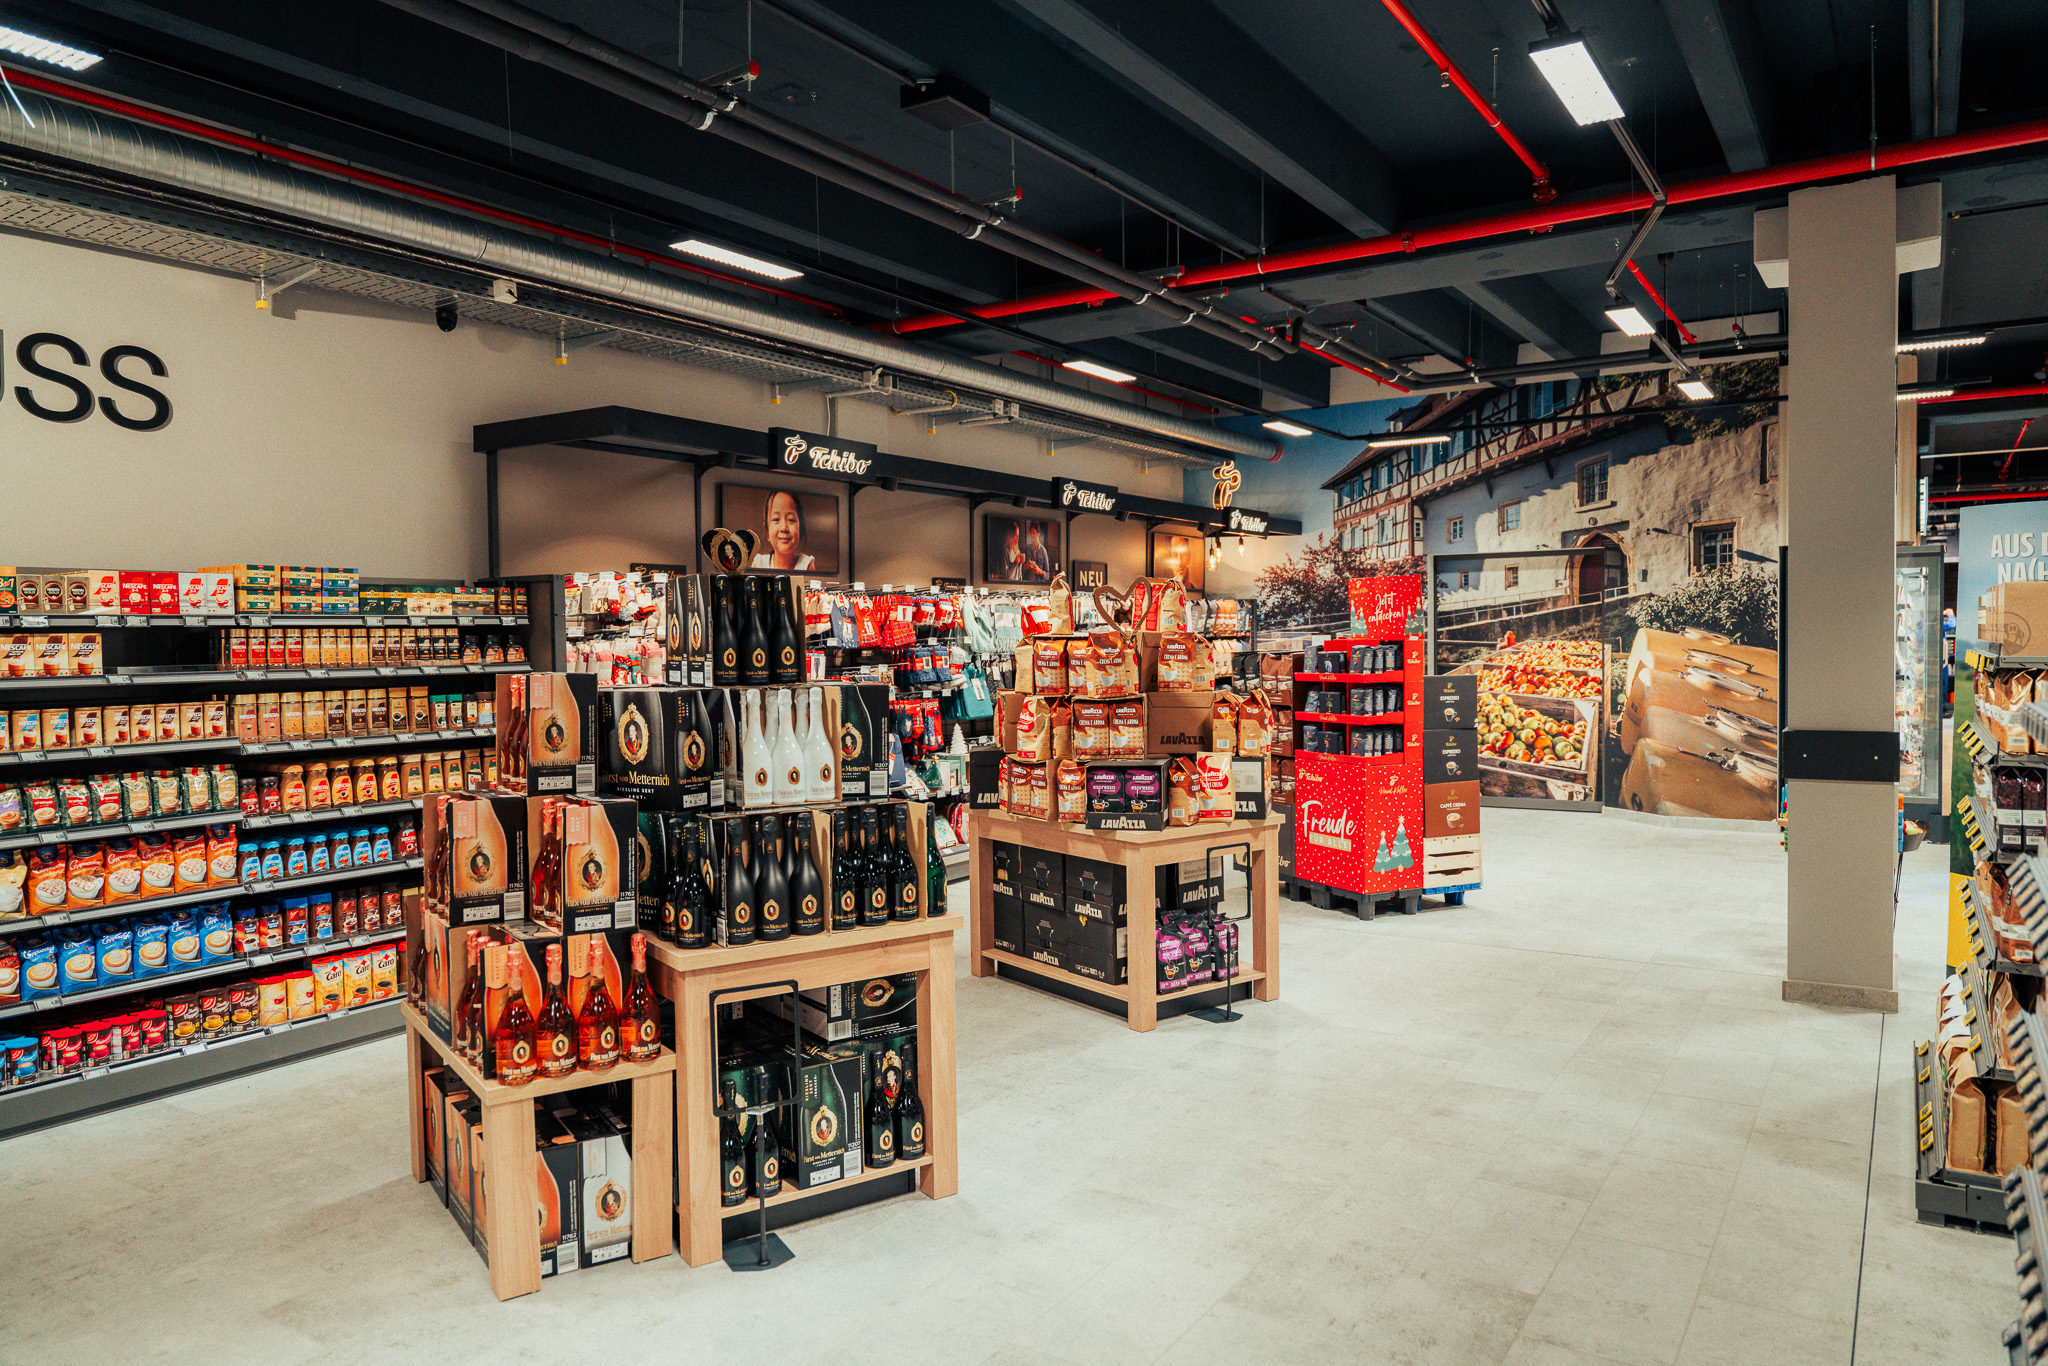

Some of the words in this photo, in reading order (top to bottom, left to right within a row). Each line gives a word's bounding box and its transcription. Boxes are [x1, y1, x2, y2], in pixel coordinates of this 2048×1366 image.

[809, 446, 871, 474] Tchibo
[1078, 490, 1115, 510] Tchibo
[1241, 516, 1267, 532] Tchibo
[1991, 533, 2034, 558] AUS
[1080, 571, 1104, 587] NEU
[1375, 592, 1397, 610] Jetzt
[1368, 606, 1404, 625] entdecken!
[1160, 732, 1205, 745] LAVAZZA
[629, 771, 670, 786] Metternich
[1305, 772, 1323, 782] Tchibo
[1101, 816, 1146, 829] LAVAZZA
[1301, 800, 1357, 843] Freude
[1310, 833, 1324, 843] FÜR
[1030, 892, 1054, 906] LAVAZZA
[1075, 903, 1102, 919] LAVAZZA
[378, 958, 394, 969] Caro
[1033, 951, 1059, 966] LAVAZZA
[326, 970, 341, 981] Caro
[356, 964, 370, 975] Caro
[821, 1148, 845, 1158] Metternich
